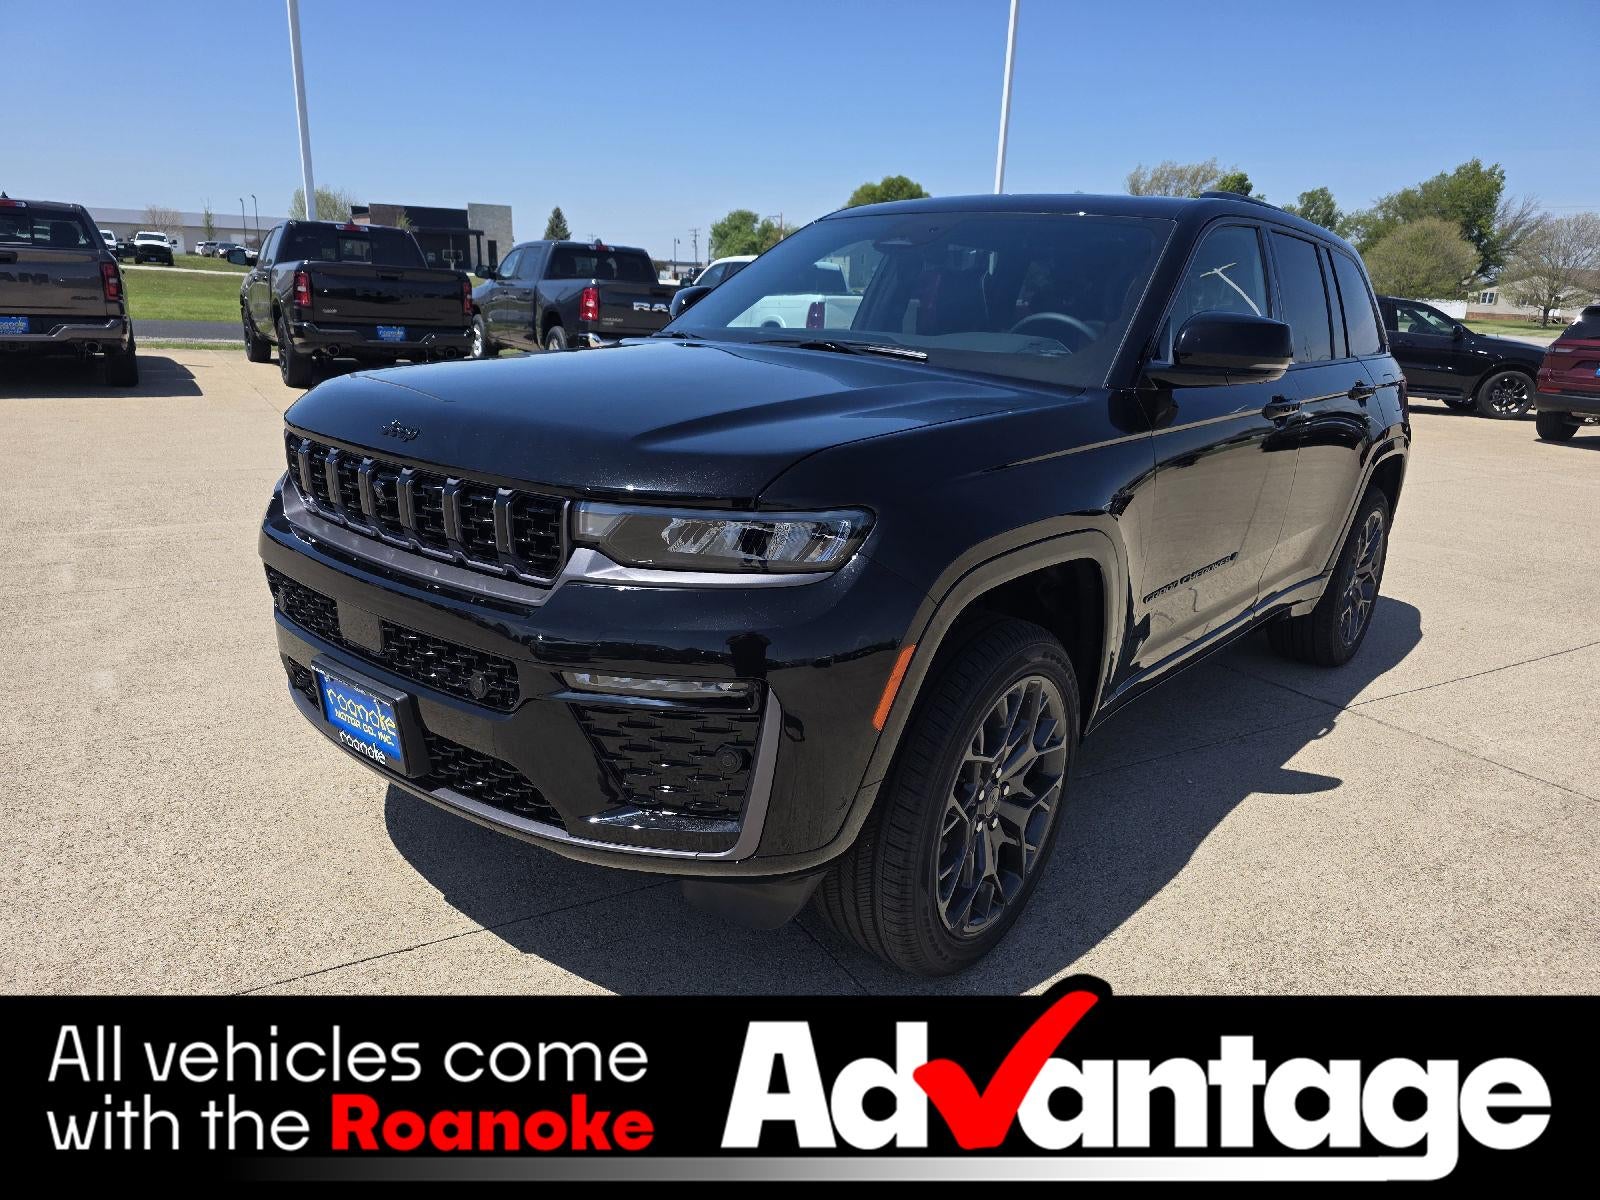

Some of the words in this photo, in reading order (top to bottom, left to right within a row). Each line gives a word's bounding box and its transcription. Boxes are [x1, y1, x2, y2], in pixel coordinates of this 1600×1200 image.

[632, 301, 670, 313] RA
[326, 688, 397, 737] roanoke
[334, 708, 361, 729] MOTOR
[339, 730, 386, 765] roanoke
